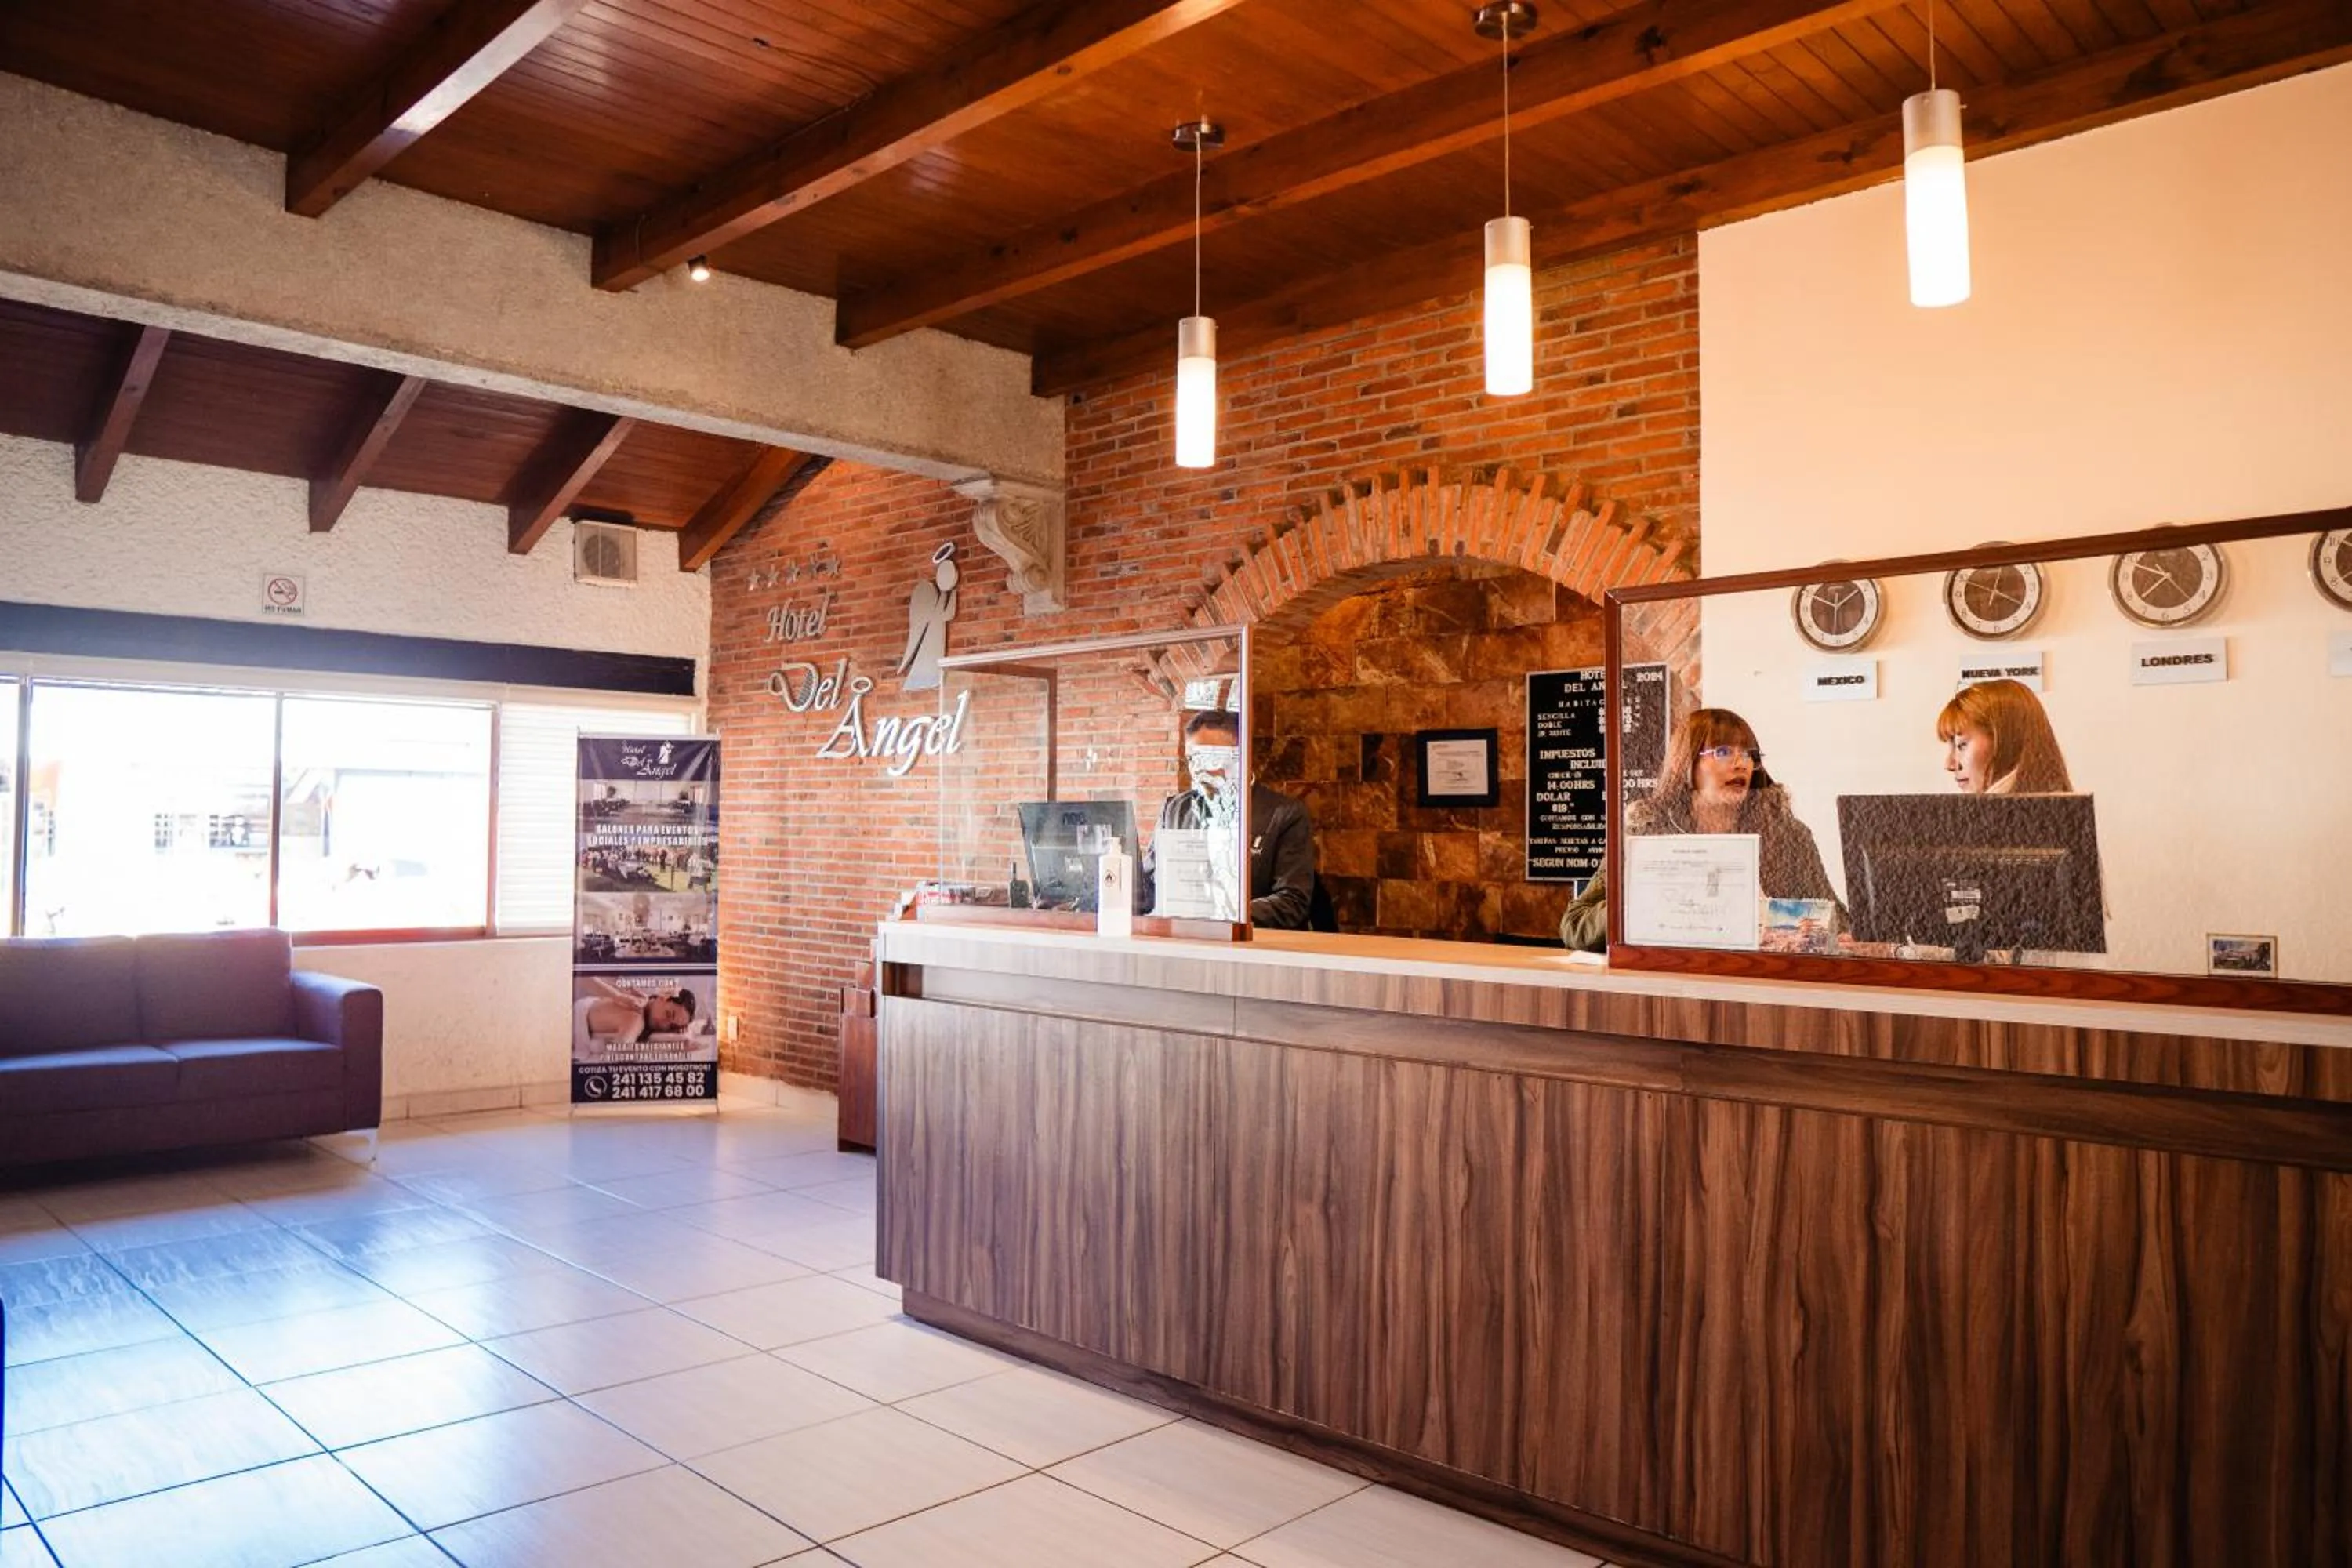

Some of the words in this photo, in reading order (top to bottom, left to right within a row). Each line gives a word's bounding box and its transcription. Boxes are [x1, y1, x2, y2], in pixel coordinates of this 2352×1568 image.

[764, 592, 838, 642] Hotel
[2140, 653, 2214, 667] LONDRES
[1580, 671, 1606, 681] HOTE
[1962, 668, 2000, 679] NUEVA
[2006, 666, 2039, 677] YORK
[765, 657, 848, 712] Del
[1817, 675, 1865, 686] MEXICO
[1564, 683, 1586, 693] DEL
[1539, 748, 1596, 760] IMPUESTOS
[1536, 791, 1572, 802] DOLAR
[612, 1073, 636, 1086] 241
[639, 1073, 662, 1085] 135
[666, 1072, 684, 1084] 45
[688, 1071, 706, 1083] 82
[612, 1086, 636, 1099] 241
[639, 1086, 662, 1098] 417
[666, 1085, 684, 1098] 68
[687, 1084, 706, 1097] 00
